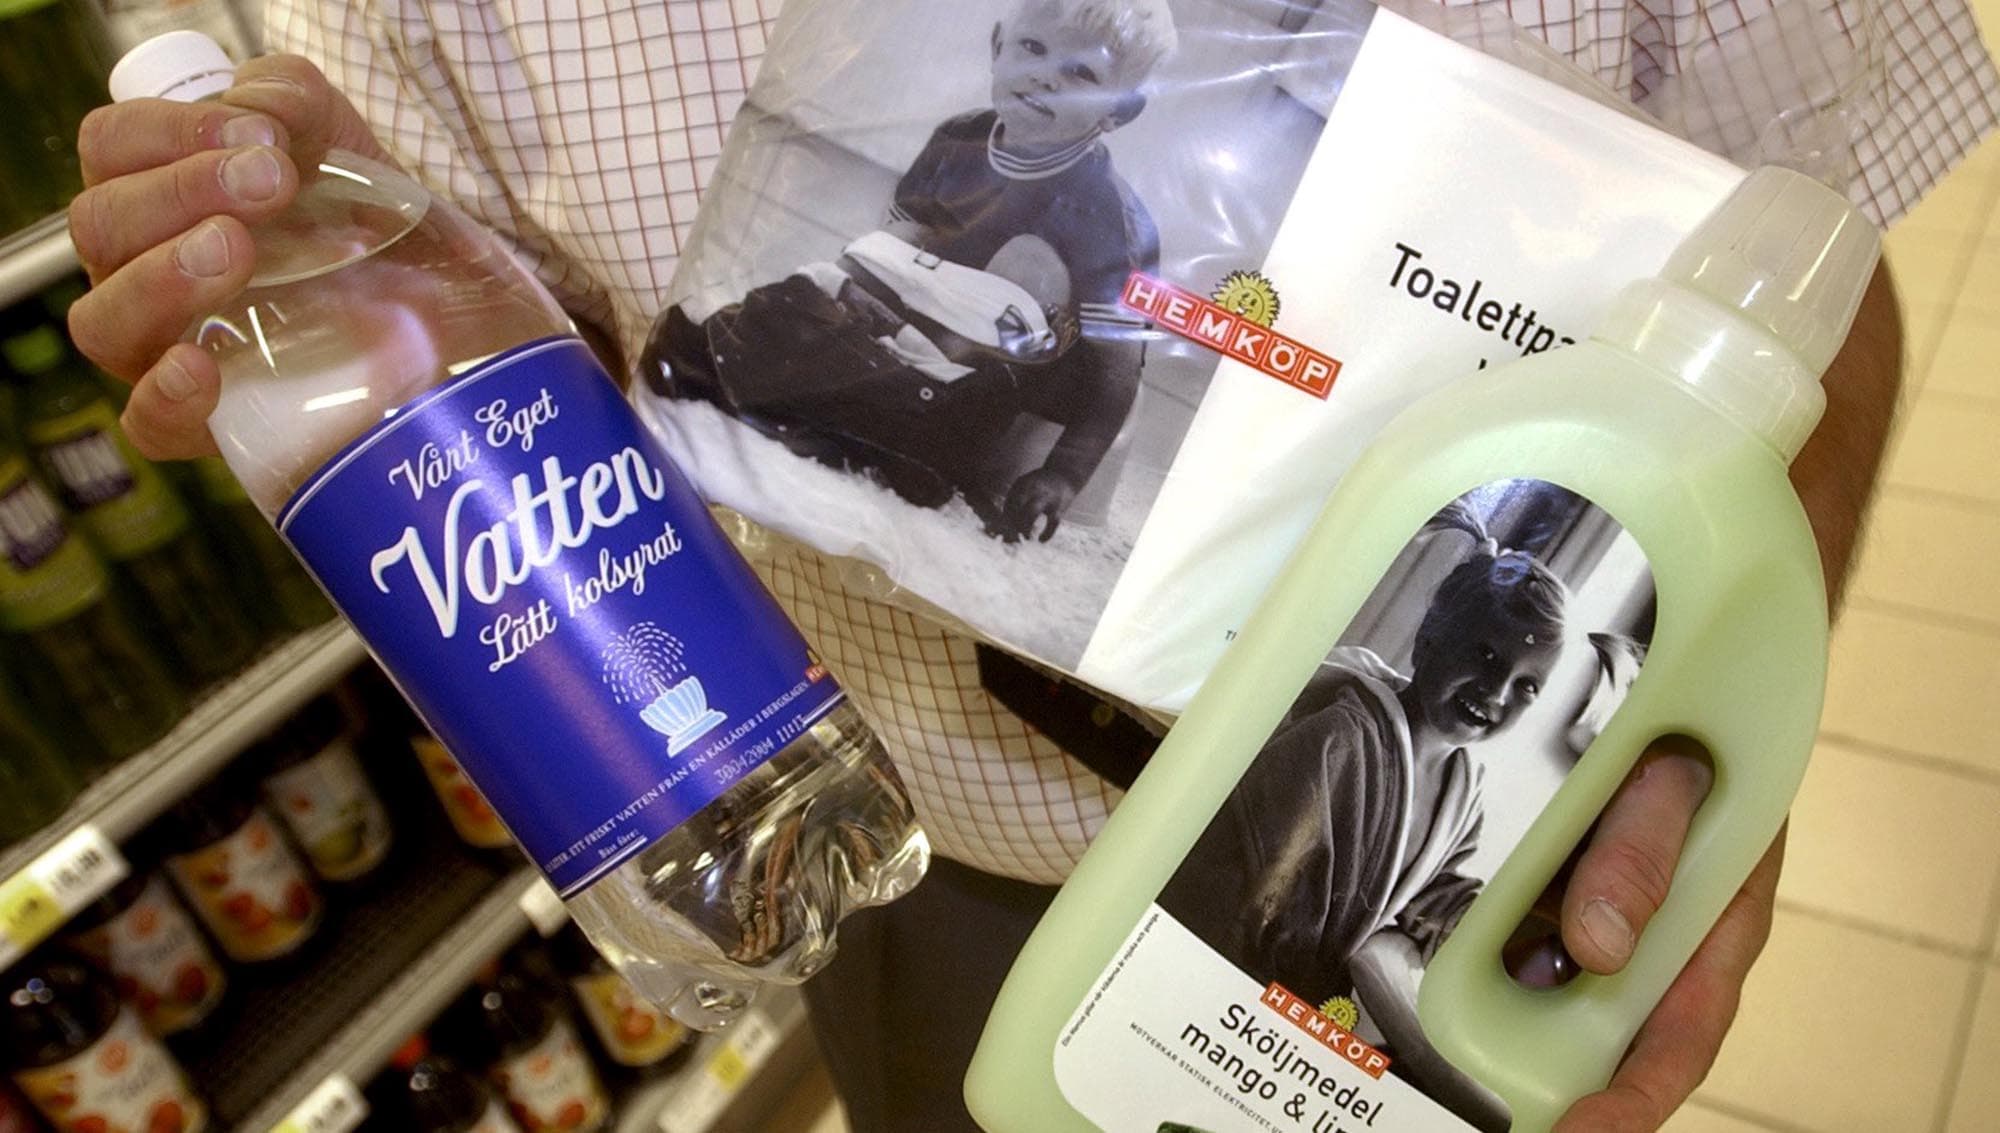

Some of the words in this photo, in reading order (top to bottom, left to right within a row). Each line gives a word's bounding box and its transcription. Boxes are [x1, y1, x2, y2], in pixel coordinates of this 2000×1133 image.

[1127, 277, 1333, 388] HEMKÖP
[388, 428, 480, 500] Vårt
[475, 387, 560, 451] Eget
[370, 446, 665, 639] Vatten
[479, 599, 558, 673] Lätt
[565, 521, 682, 619] kolsyrat
[614, 786, 660, 825] VATTEN
[656, 763, 691, 794] FRÅN
[687, 753, 707, 772] EN
[1129, 1022, 1181, 1063] MOTVERKAR
[1178, 1059, 1213, 1088] STATISK
[1180, 1022, 1278, 1101] mango
[1284, 1092, 1307, 1123] &
[1312, 1109, 1350, 1133] li
[1219, 1002, 1384, 1128] Sköljmedel
[1267, 987, 1385, 1074] HEMKÖP
